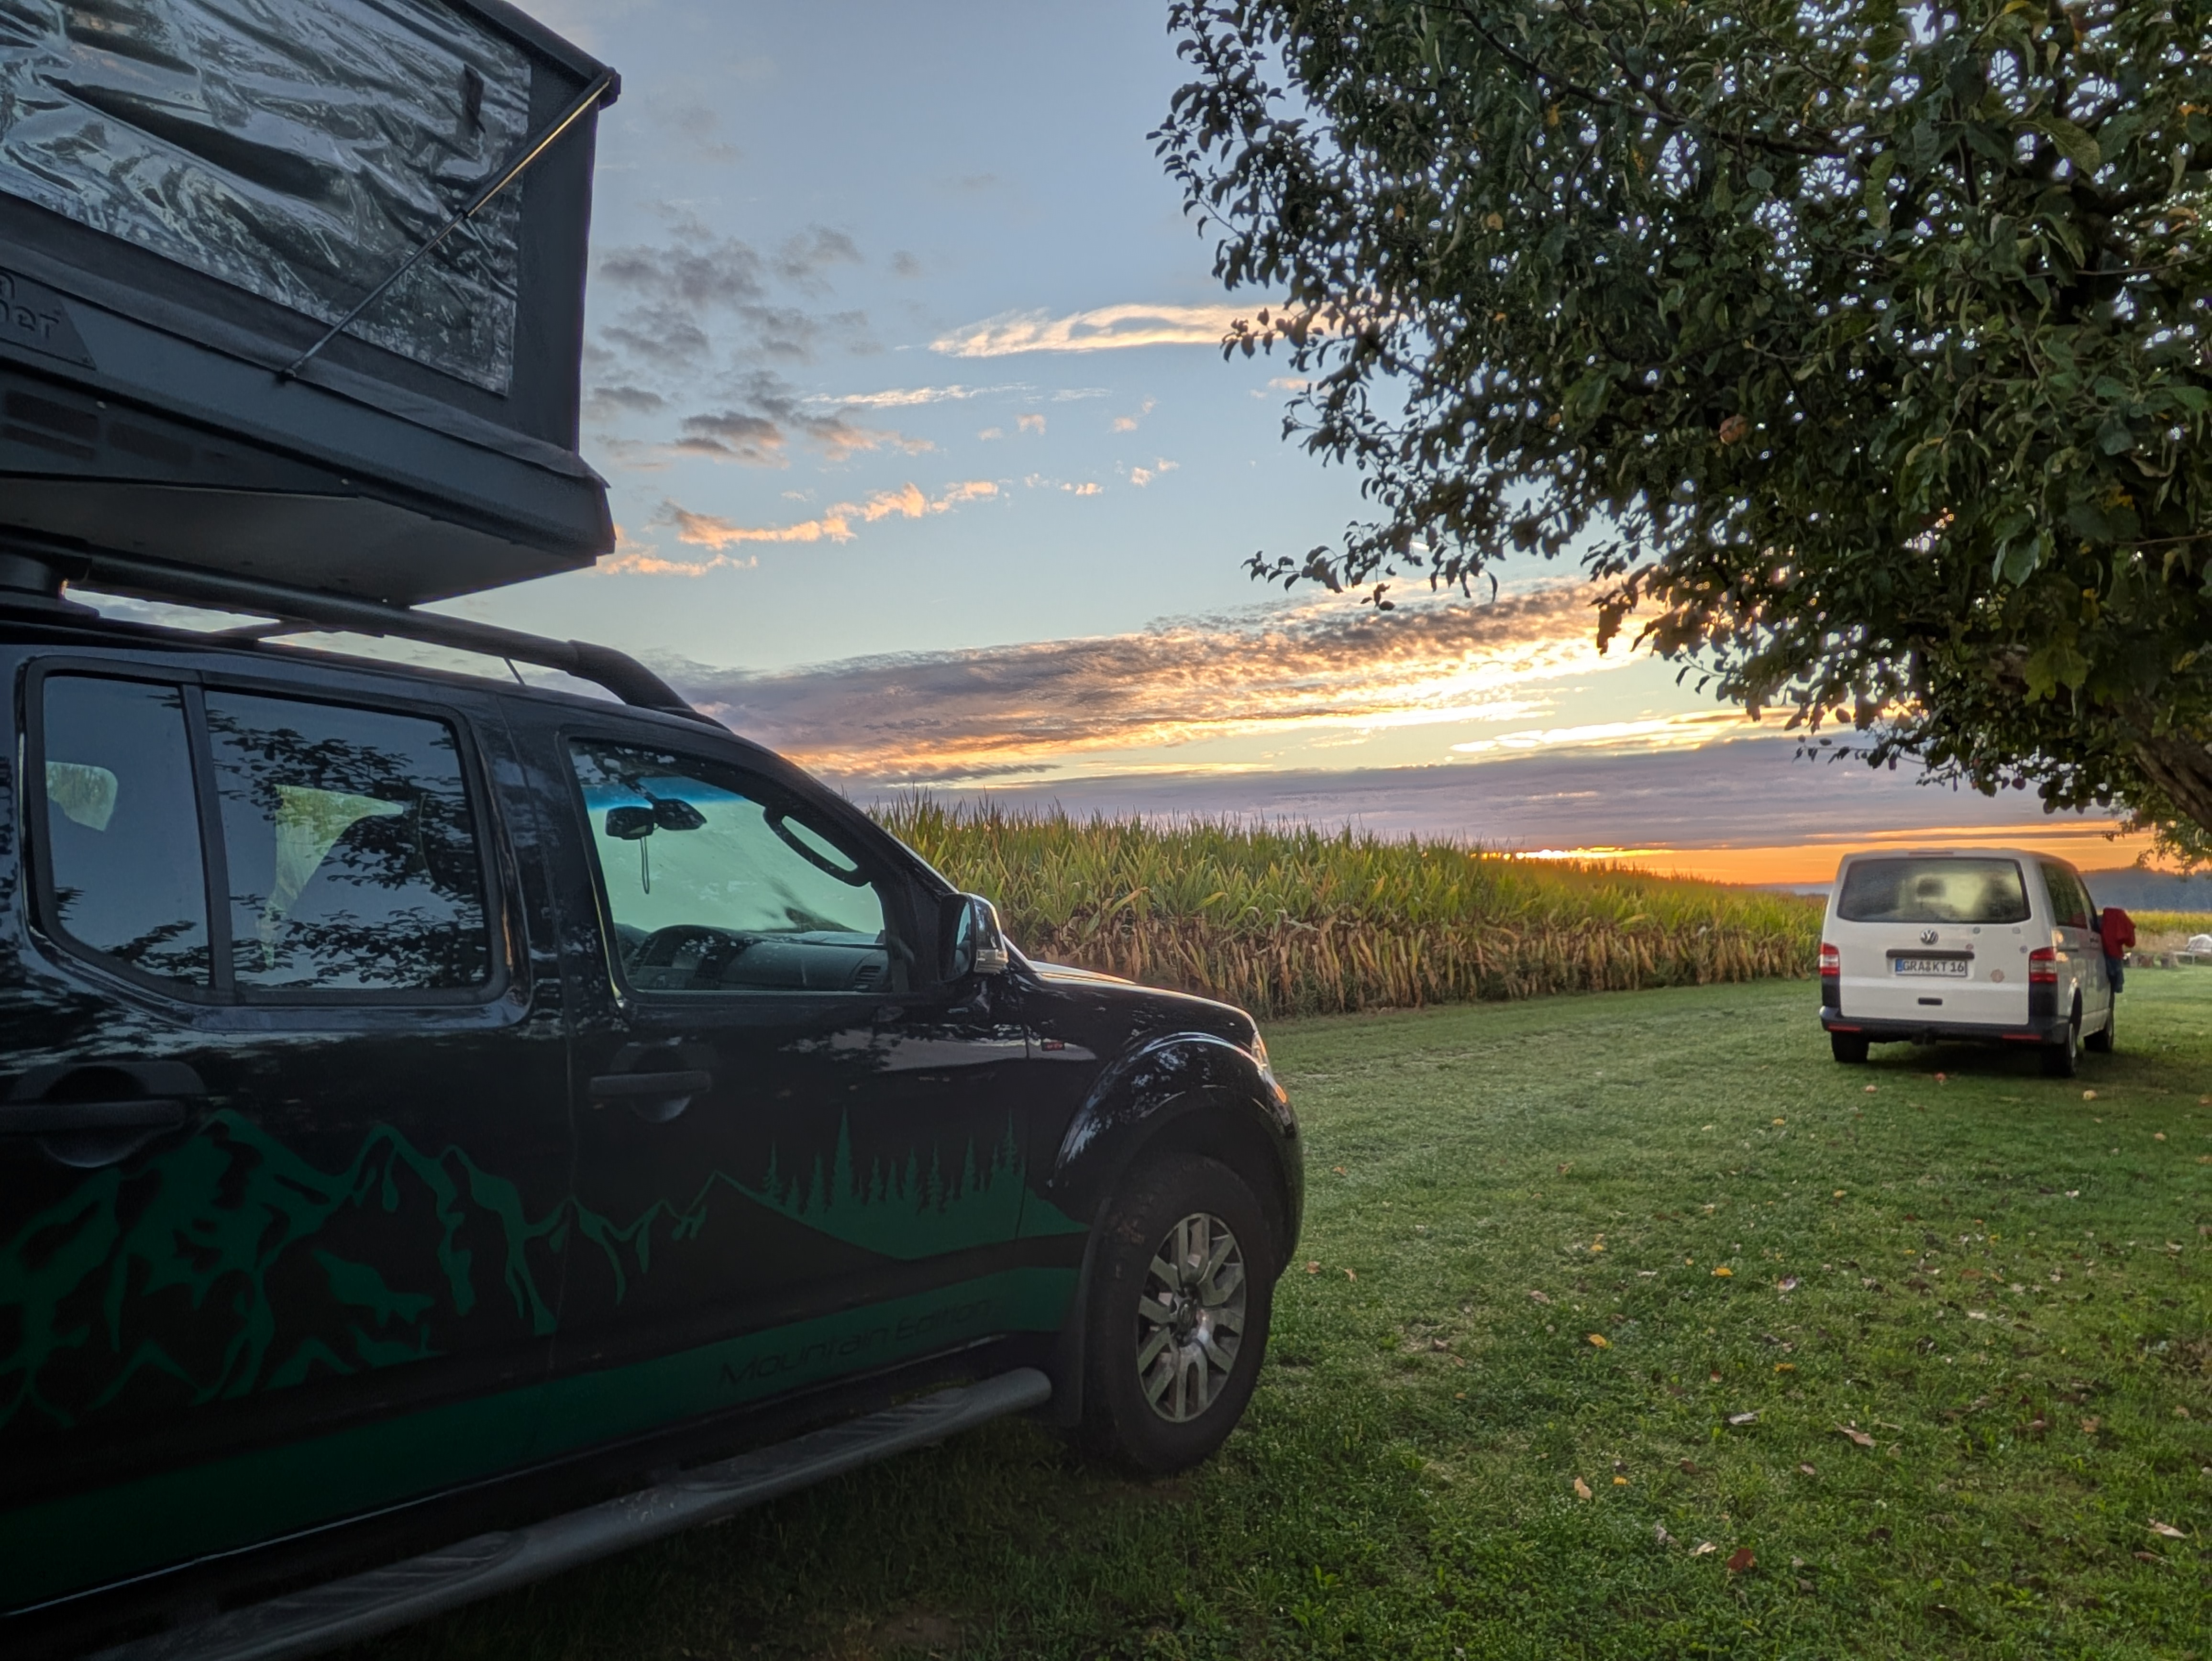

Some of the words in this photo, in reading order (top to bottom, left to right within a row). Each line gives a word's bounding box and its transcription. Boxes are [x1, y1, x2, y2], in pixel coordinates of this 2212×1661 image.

[1903, 961, 1924, 971] GRA
[1933, 962, 1947, 971] KT
[1951, 962, 1964, 972] 16
[719, 1324, 887, 1385] Mountain
[895, 1299, 989, 1340] Edition
